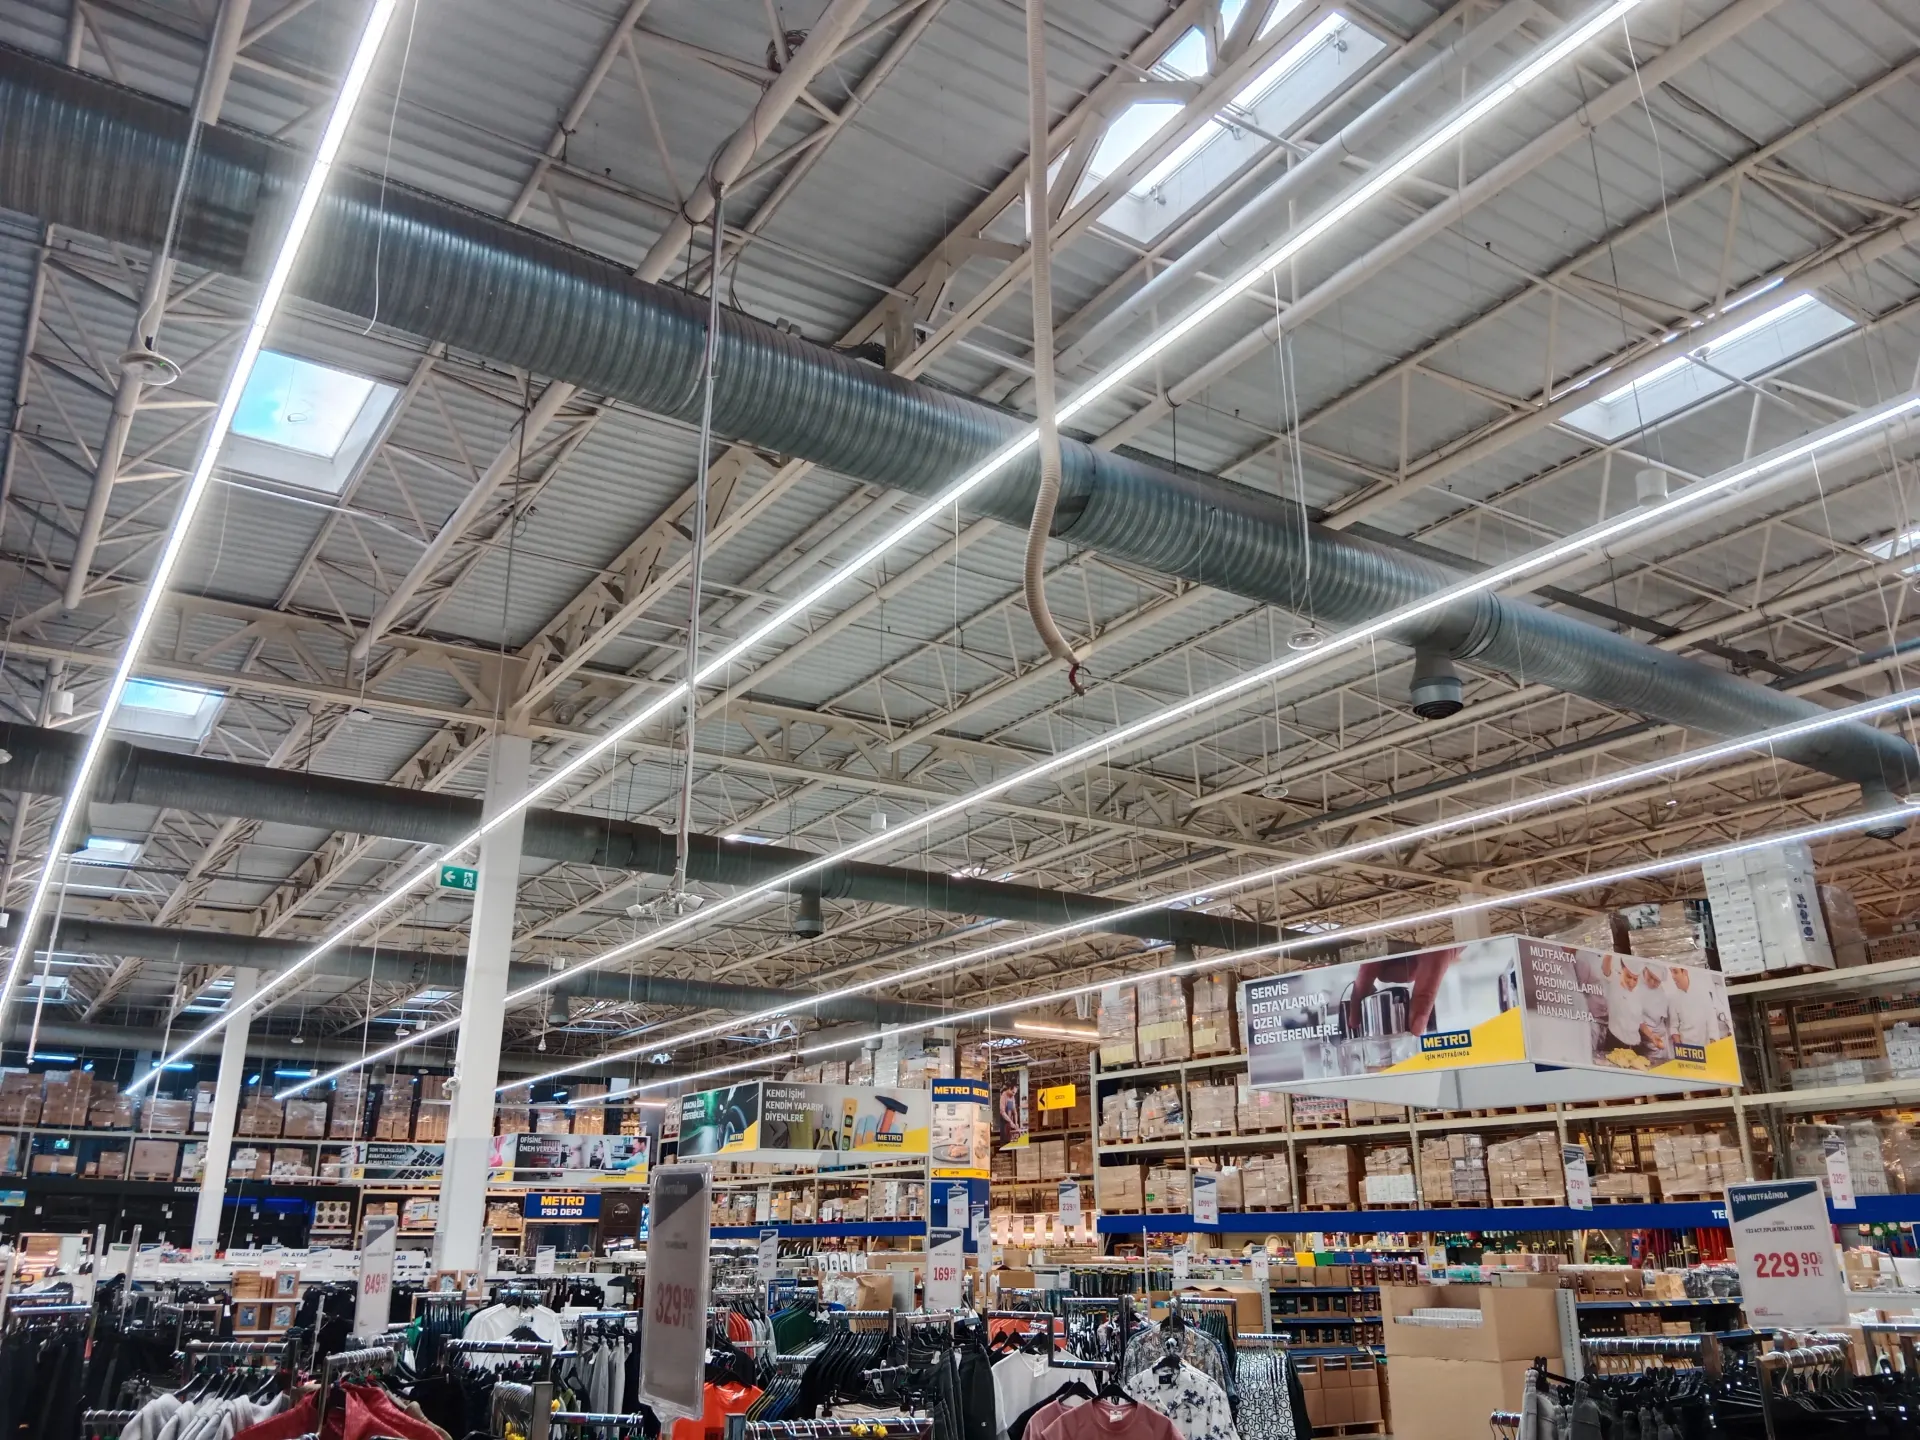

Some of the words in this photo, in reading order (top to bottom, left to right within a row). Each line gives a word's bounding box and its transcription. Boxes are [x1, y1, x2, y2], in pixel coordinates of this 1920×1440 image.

[1529, 945, 1577, 964] MUTFAKTA
[1531, 960, 1563, 976] KÜÇÜK
[1251, 981, 1289, 1000] SERVİS
[1532, 975, 1604, 996] YARDIMCILARIN
[1252, 992, 1326, 1015] DETAYLARINA
[1535, 989, 1573, 1006] GÜCÜNE
[1253, 1015, 1282, 1030] ÖZEN
[1423, 1033, 1470, 1049] METRO
[1675, 1046, 1705, 1060] METRO
[766, 1088, 788, 1098] KENDİ
[934, 1086, 970, 1095] METRO
[972, 1087, 989, 1098] METRO
[765, 1100, 793, 1110] KENDİM
[793, 1102, 824, 1112] YAPARIM
[765, 1112, 804, 1122] DİYENLERE
[877, 1133, 902, 1142] METRO
[540, 1196, 585, 1206] METRO
[1732, 1193, 1747, 1204] İŞİN
[1747, 1191, 1789, 1201] MUTFAĞINDA
[541, 1208, 558, 1216] FSD
[559, 1208, 583, 1216] DEPO
